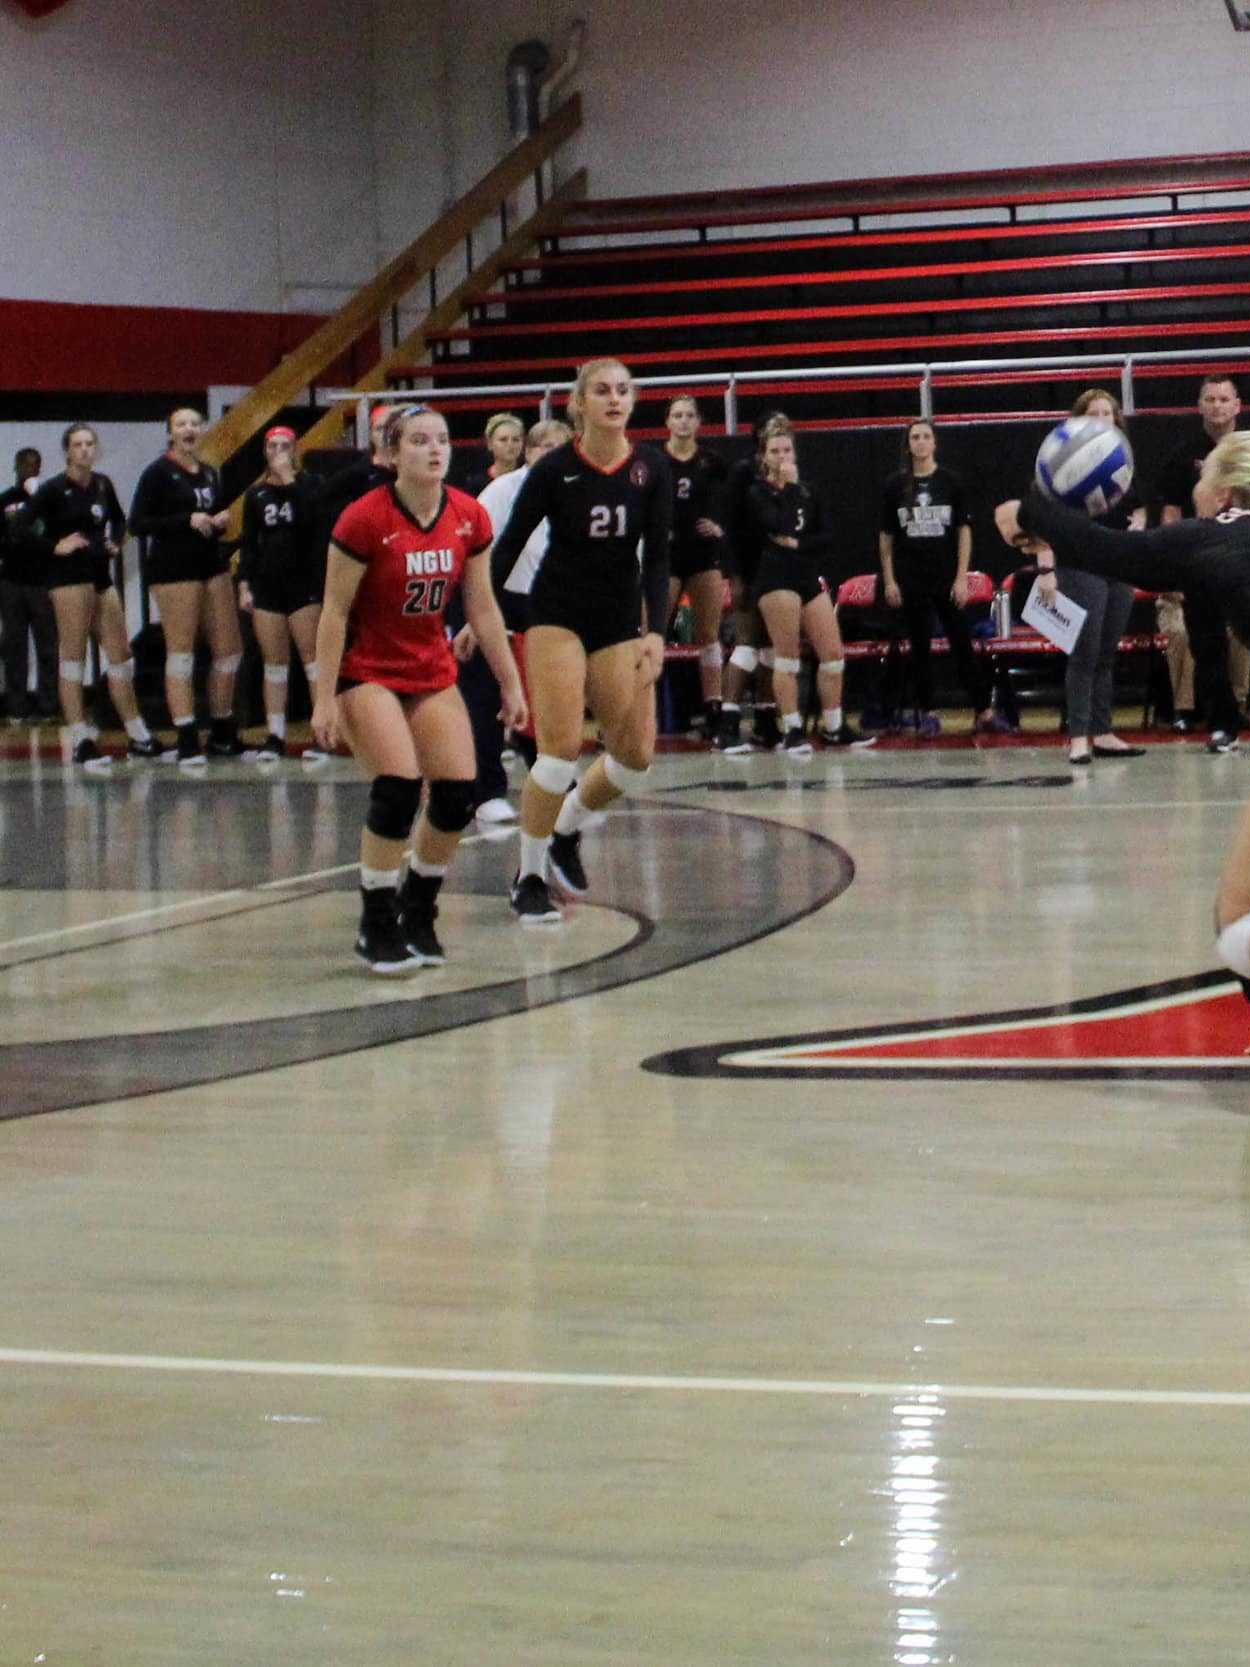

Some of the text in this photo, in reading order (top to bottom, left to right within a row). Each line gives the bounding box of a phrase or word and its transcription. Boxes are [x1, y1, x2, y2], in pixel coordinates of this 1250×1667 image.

[676, 477, 693, 499] 2
[264, 501, 294, 526] 24
[588, 504, 628, 538] 21
[405, 547, 454, 576] NGU
[402, 578, 448, 616] 20
